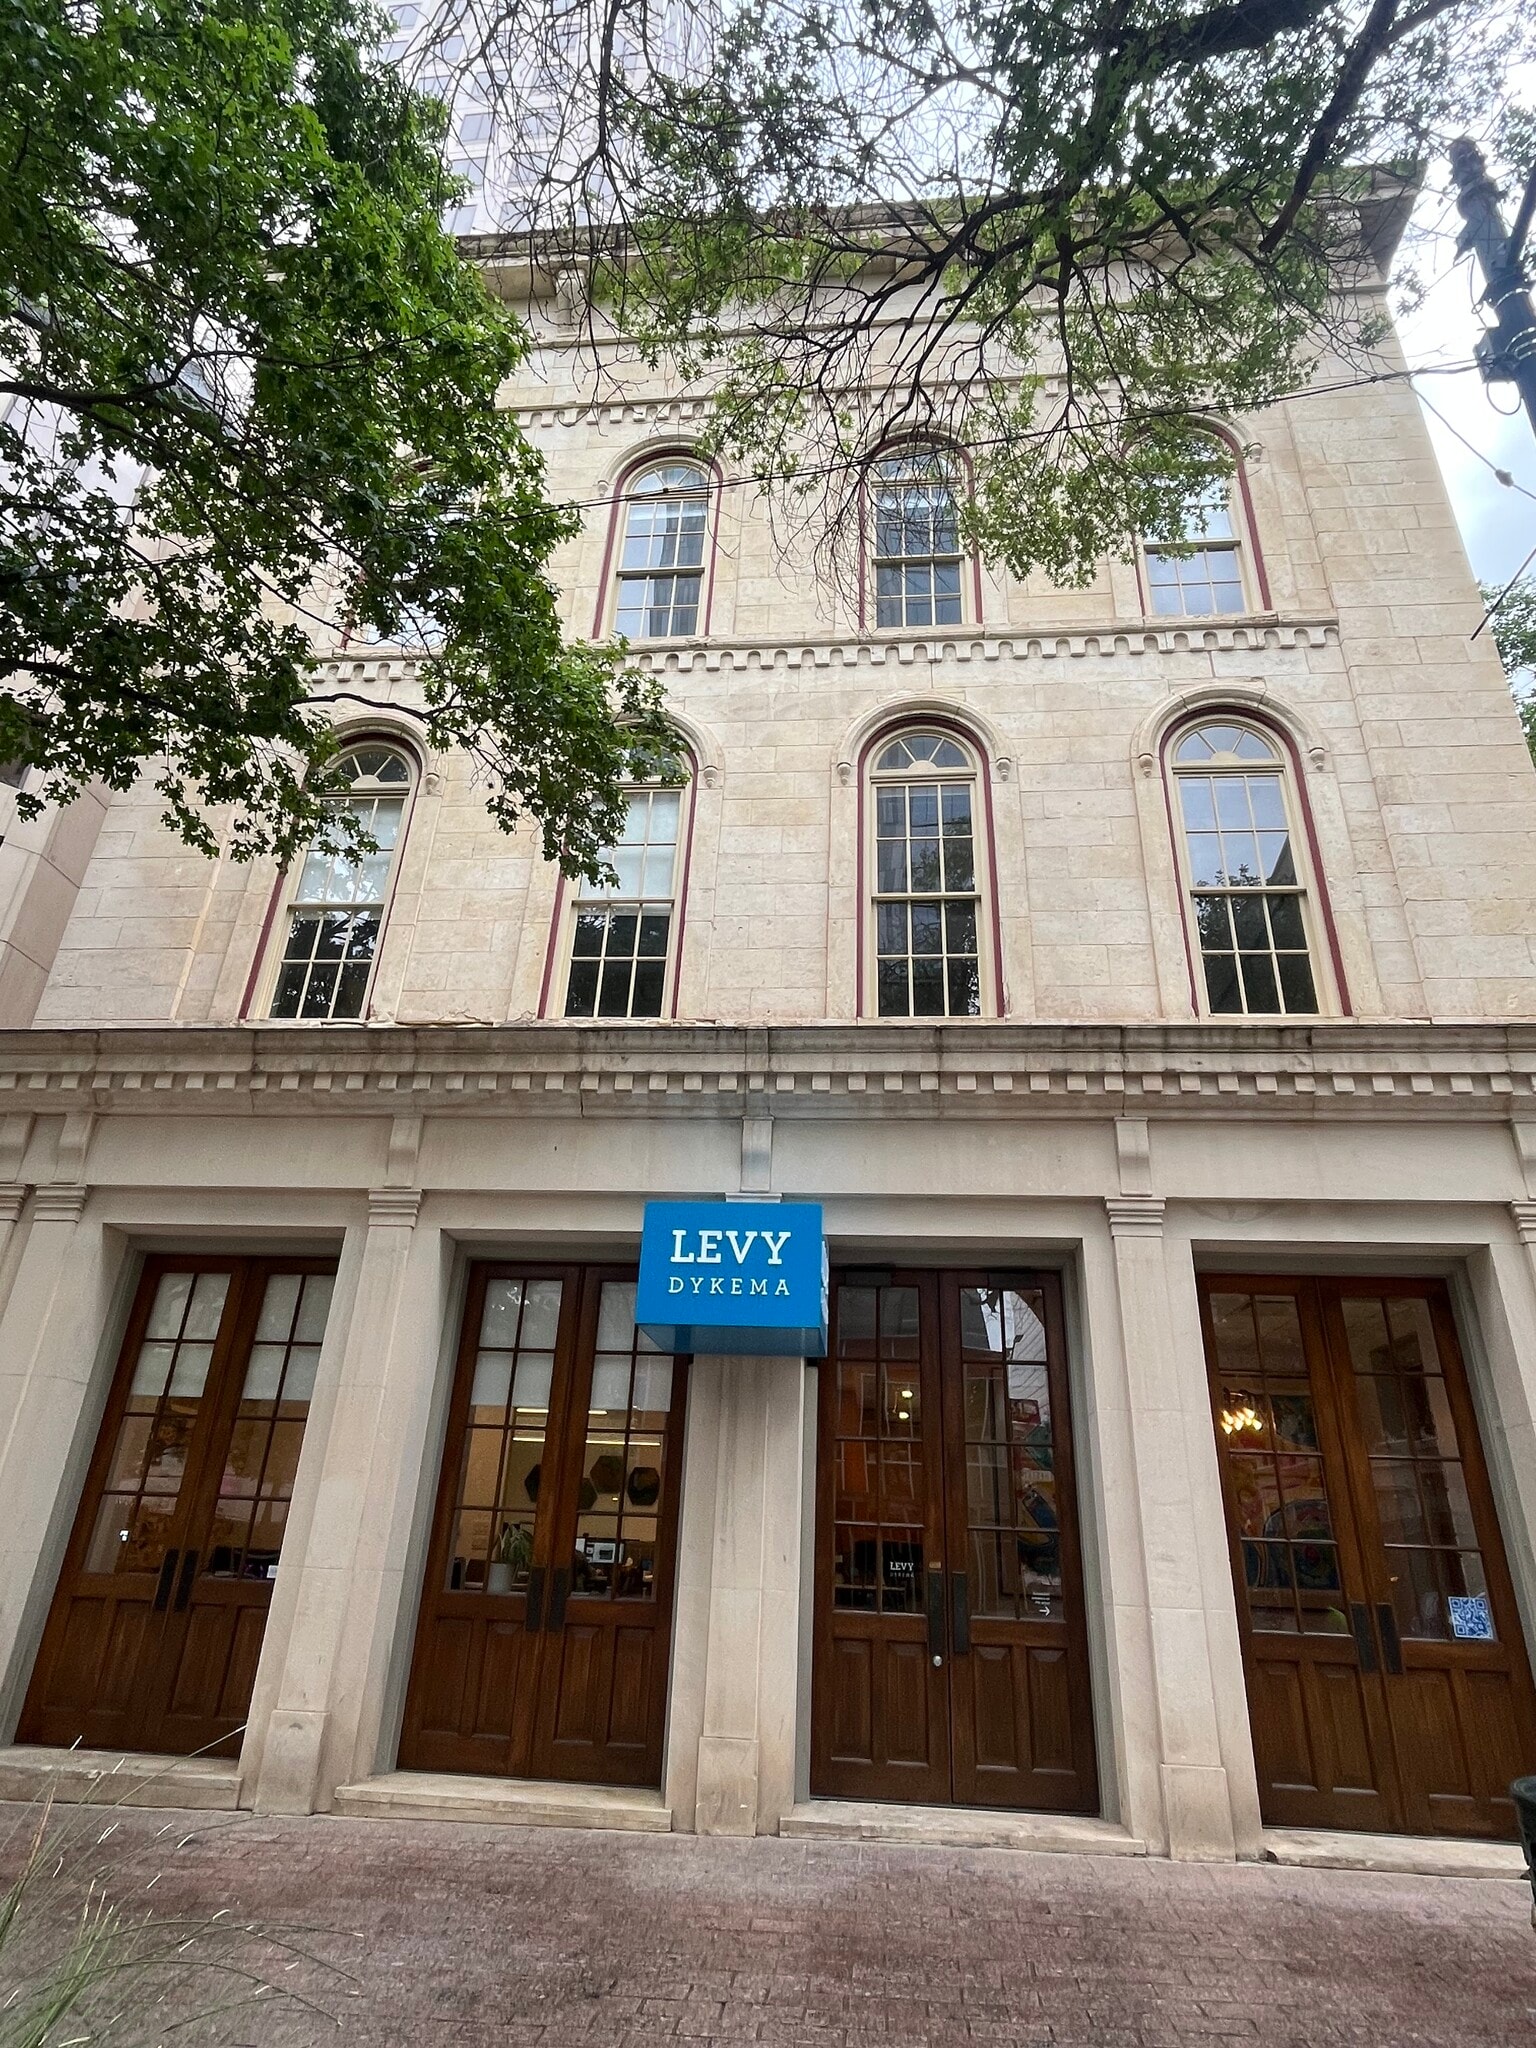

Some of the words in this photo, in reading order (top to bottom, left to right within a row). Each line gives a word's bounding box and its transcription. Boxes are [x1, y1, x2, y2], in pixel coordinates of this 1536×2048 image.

[670, 1229, 792, 1265] LEVY
[668, 1276, 791, 1296] DYKEMA
[889, 1561, 914, 1571] LEVY
